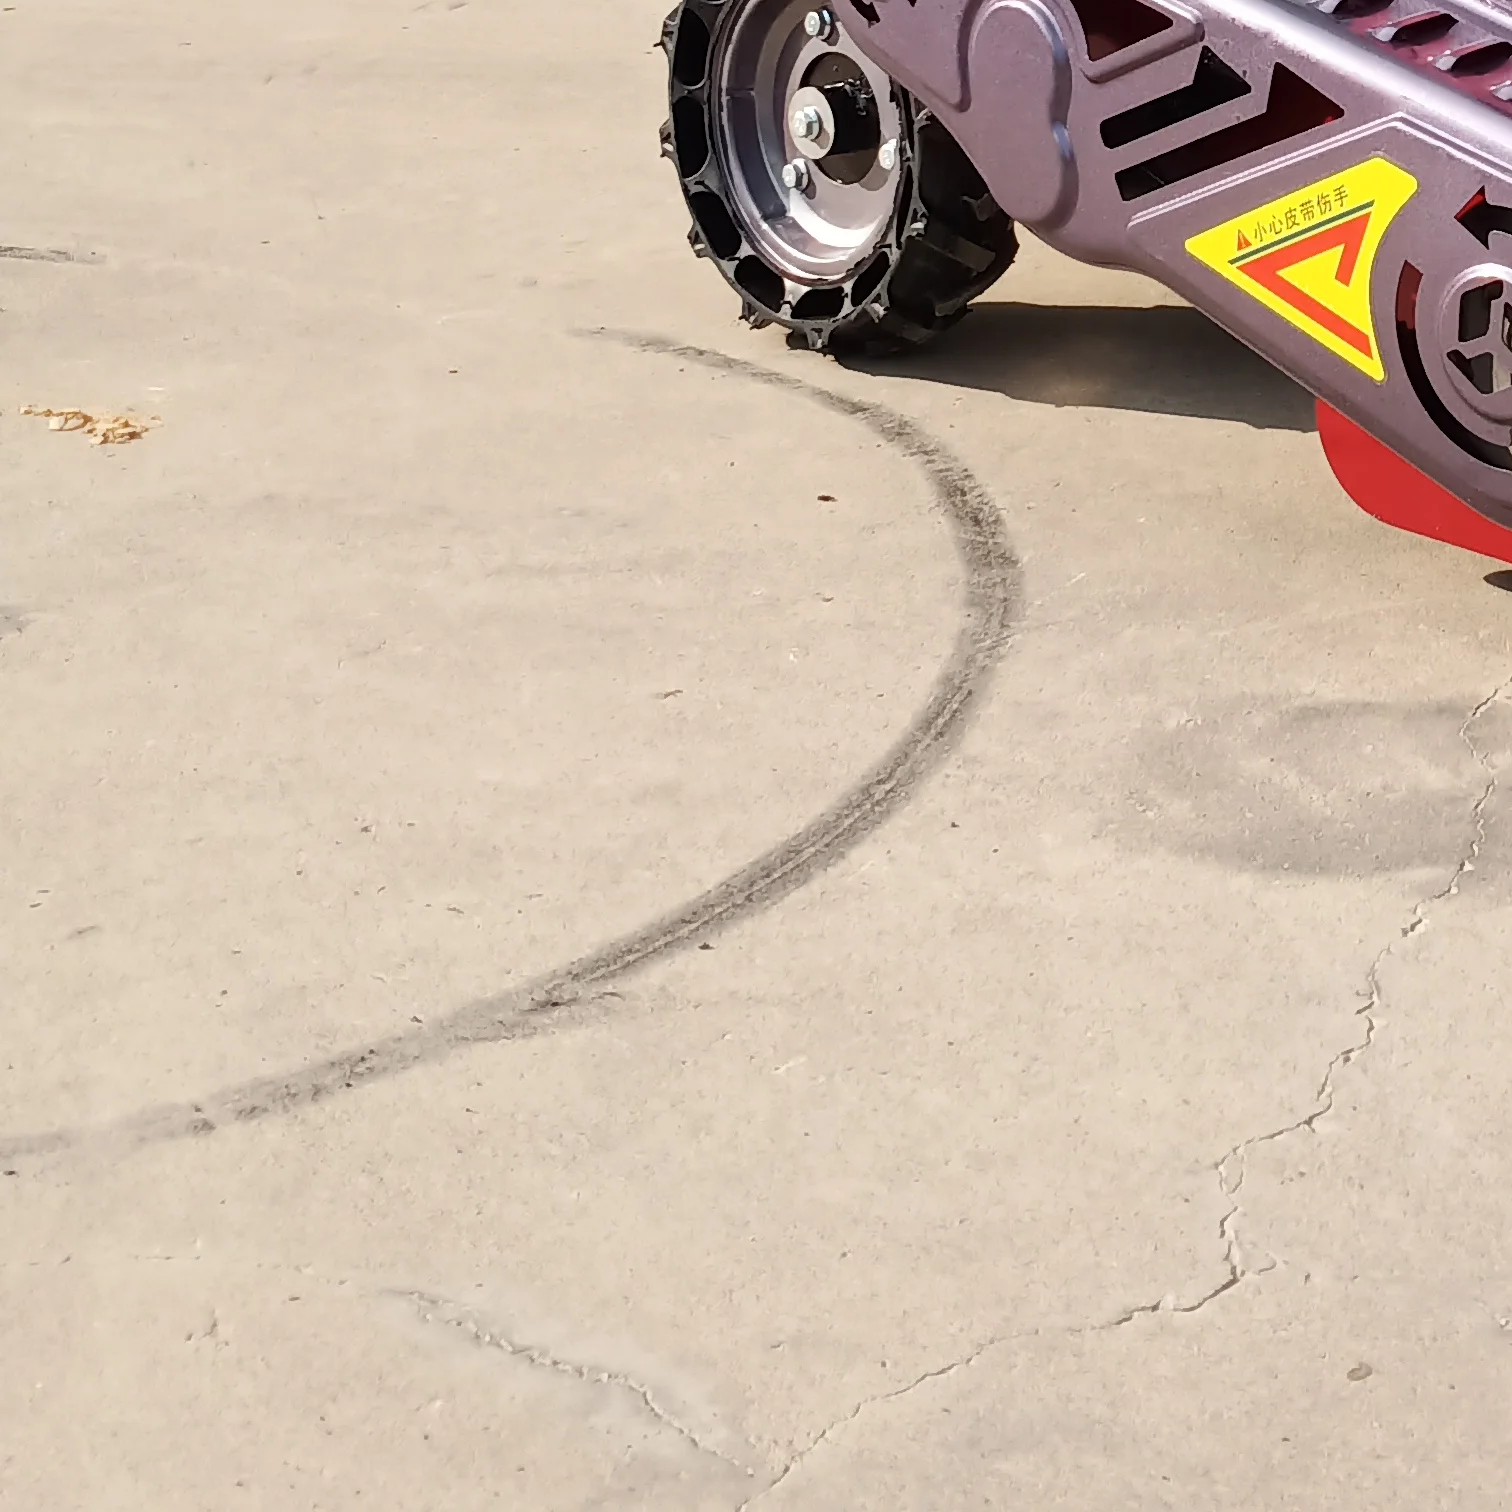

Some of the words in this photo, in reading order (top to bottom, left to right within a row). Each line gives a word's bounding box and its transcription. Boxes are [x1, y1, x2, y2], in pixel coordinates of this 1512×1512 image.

[1254, 184, 1349, 243] 小心皮带伤手
